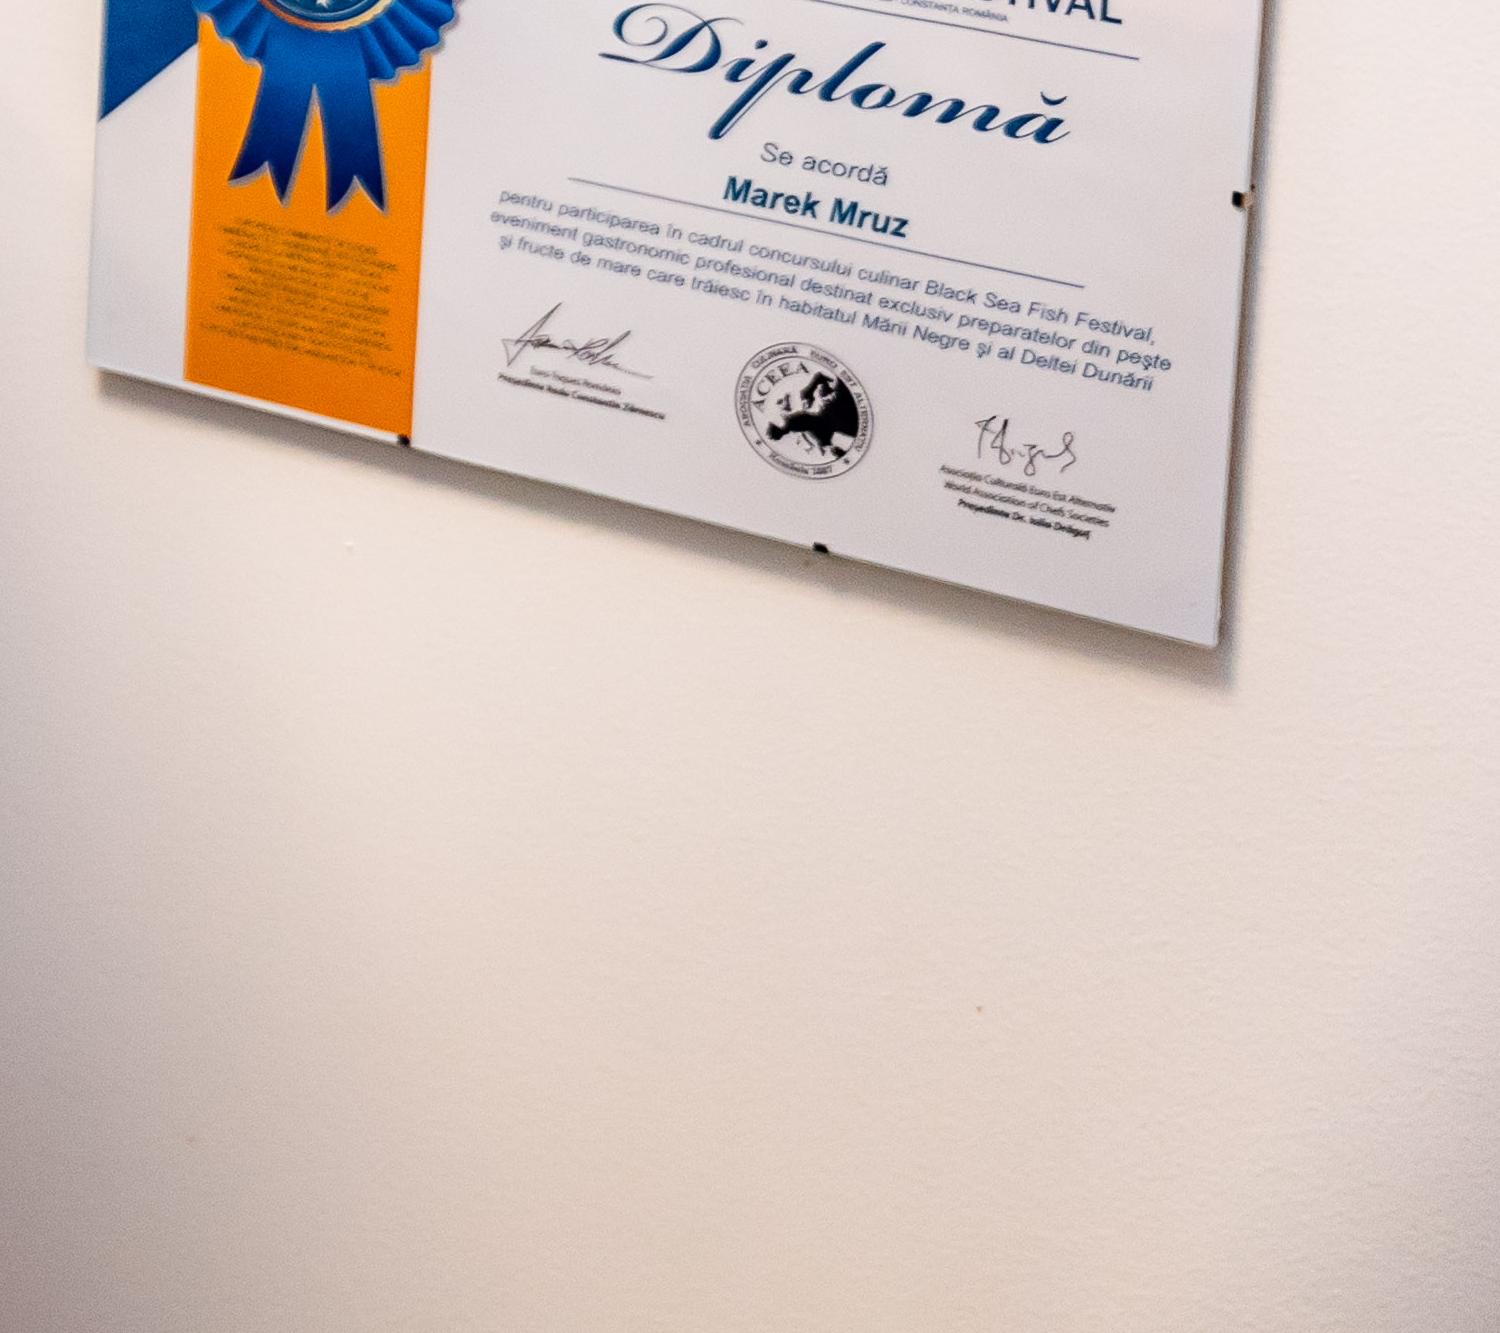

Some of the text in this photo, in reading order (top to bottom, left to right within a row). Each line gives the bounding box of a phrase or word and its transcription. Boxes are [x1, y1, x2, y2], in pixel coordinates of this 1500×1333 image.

[597, 0, 1072, 146] Diplomă
[723, 175, 911, 239] Marek Mruz
[760, 140, 891, 188] Se acordă
[490, 209, 1111, 360] eveniment gastronomic profesional destinat exclusiv preparatelor din
[499, 189, 1156, 347] pentru participarea în cadrul concursului culinar Black Sea Fish Festival,
[516, 234, 565, 261] fructe
[570, 249, 592, 267] de
[596, 257, 642, 278] mare
[646, 267, 686, 288] care
[756, 288, 775, 308] în
[778, 294, 858, 326] habitatul
[912, 324, 971, 353] Negre
[996, 345, 1017, 363] al
[1019, 348, 1078, 376] Deltei
[1081, 361, 1156, 393] Dunării
